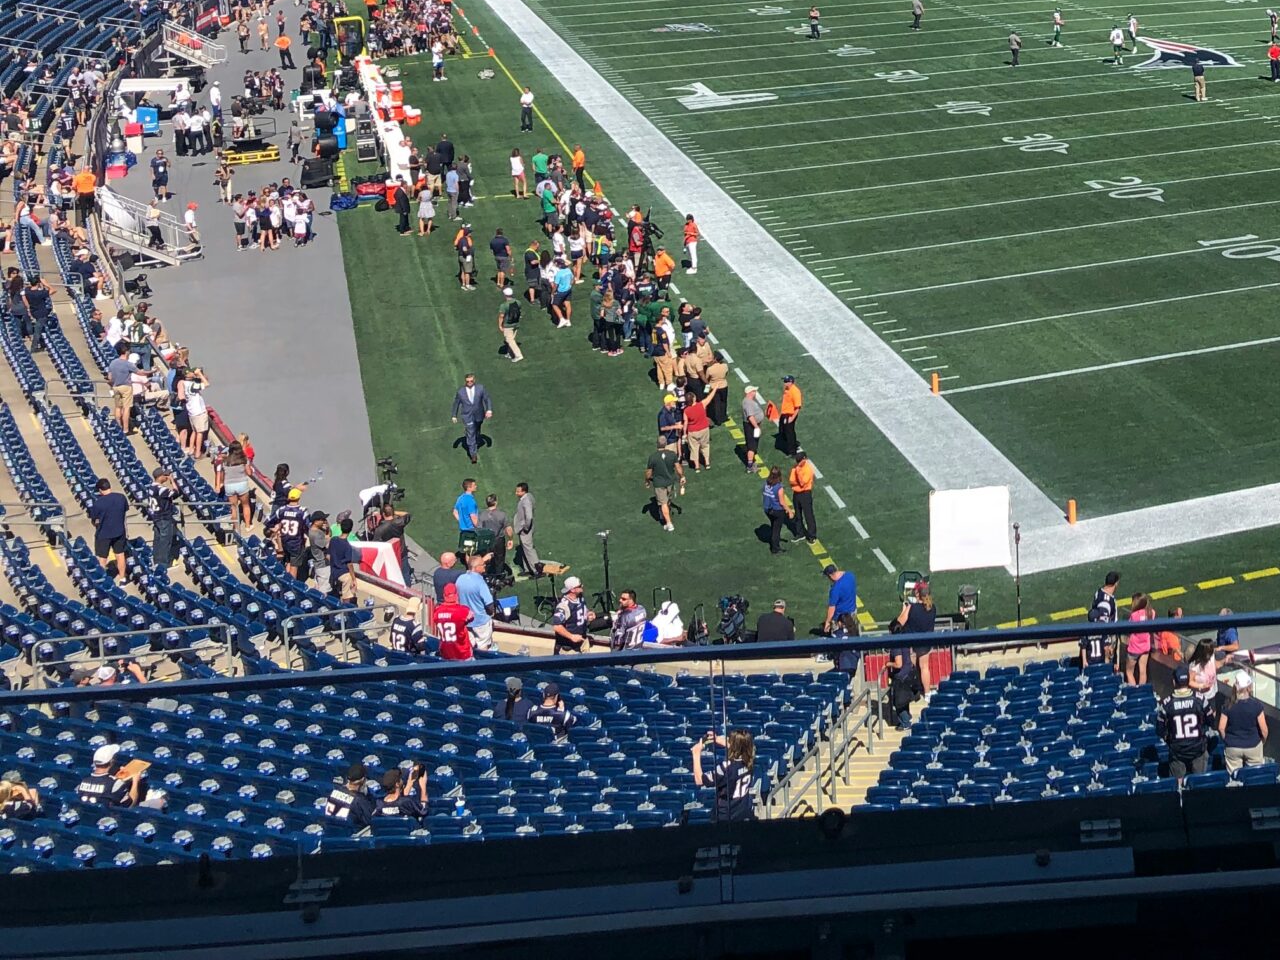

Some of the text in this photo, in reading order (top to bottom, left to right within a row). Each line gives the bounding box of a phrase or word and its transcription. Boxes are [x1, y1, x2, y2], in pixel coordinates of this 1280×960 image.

[935, 101, 992, 115] 40
[1001, 133, 1069, 152] 30
[280, 520, 299, 536] 33
[437, 622, 457, 642] 12
[392, 632, 406, 651] 12
[1090, 640, 1101, 657] 11
[1174, 700, 1194, 710] BRADY
[536, 715, 553, 723] BRADY
[1173, 714, 1199, 739] 12
[733, 774, 751, 798] 12
